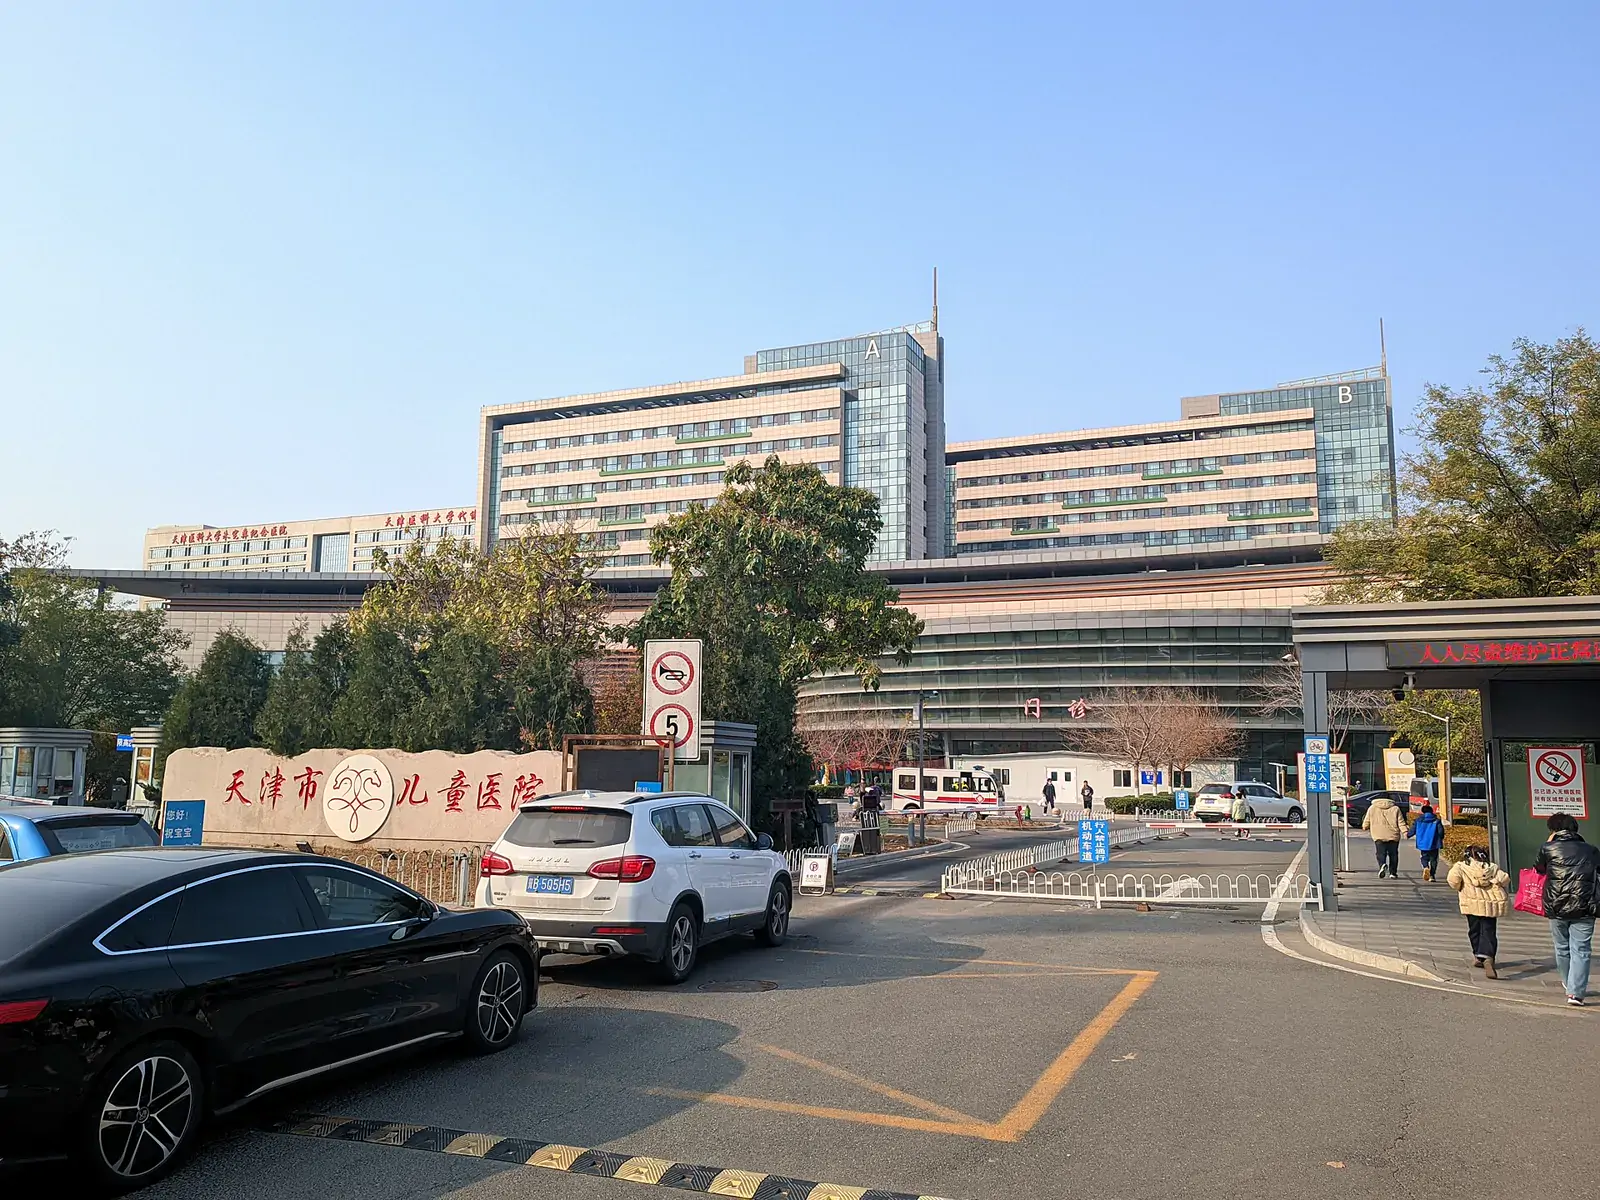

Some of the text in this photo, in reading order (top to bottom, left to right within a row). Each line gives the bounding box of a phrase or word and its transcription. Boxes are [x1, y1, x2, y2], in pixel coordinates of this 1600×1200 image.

[865, 339, 881, 360] A
[1338, 386, 1353, 404] B
[1024, 697, 1092, 719] 门诊
[666, 714, 678, 737] 5
[1307, 755, 1317, 790] 非机动车
[1318, 755, 1328, 790] 禁止入内
[223, 766, 544, 813] 天津市 儿童医院
[165, 827, 192, 839] 祝宝宝
[1081, 821, 1092, 861] 机动车道
[1094, 821, 1106, 862] 行人禁止通行
